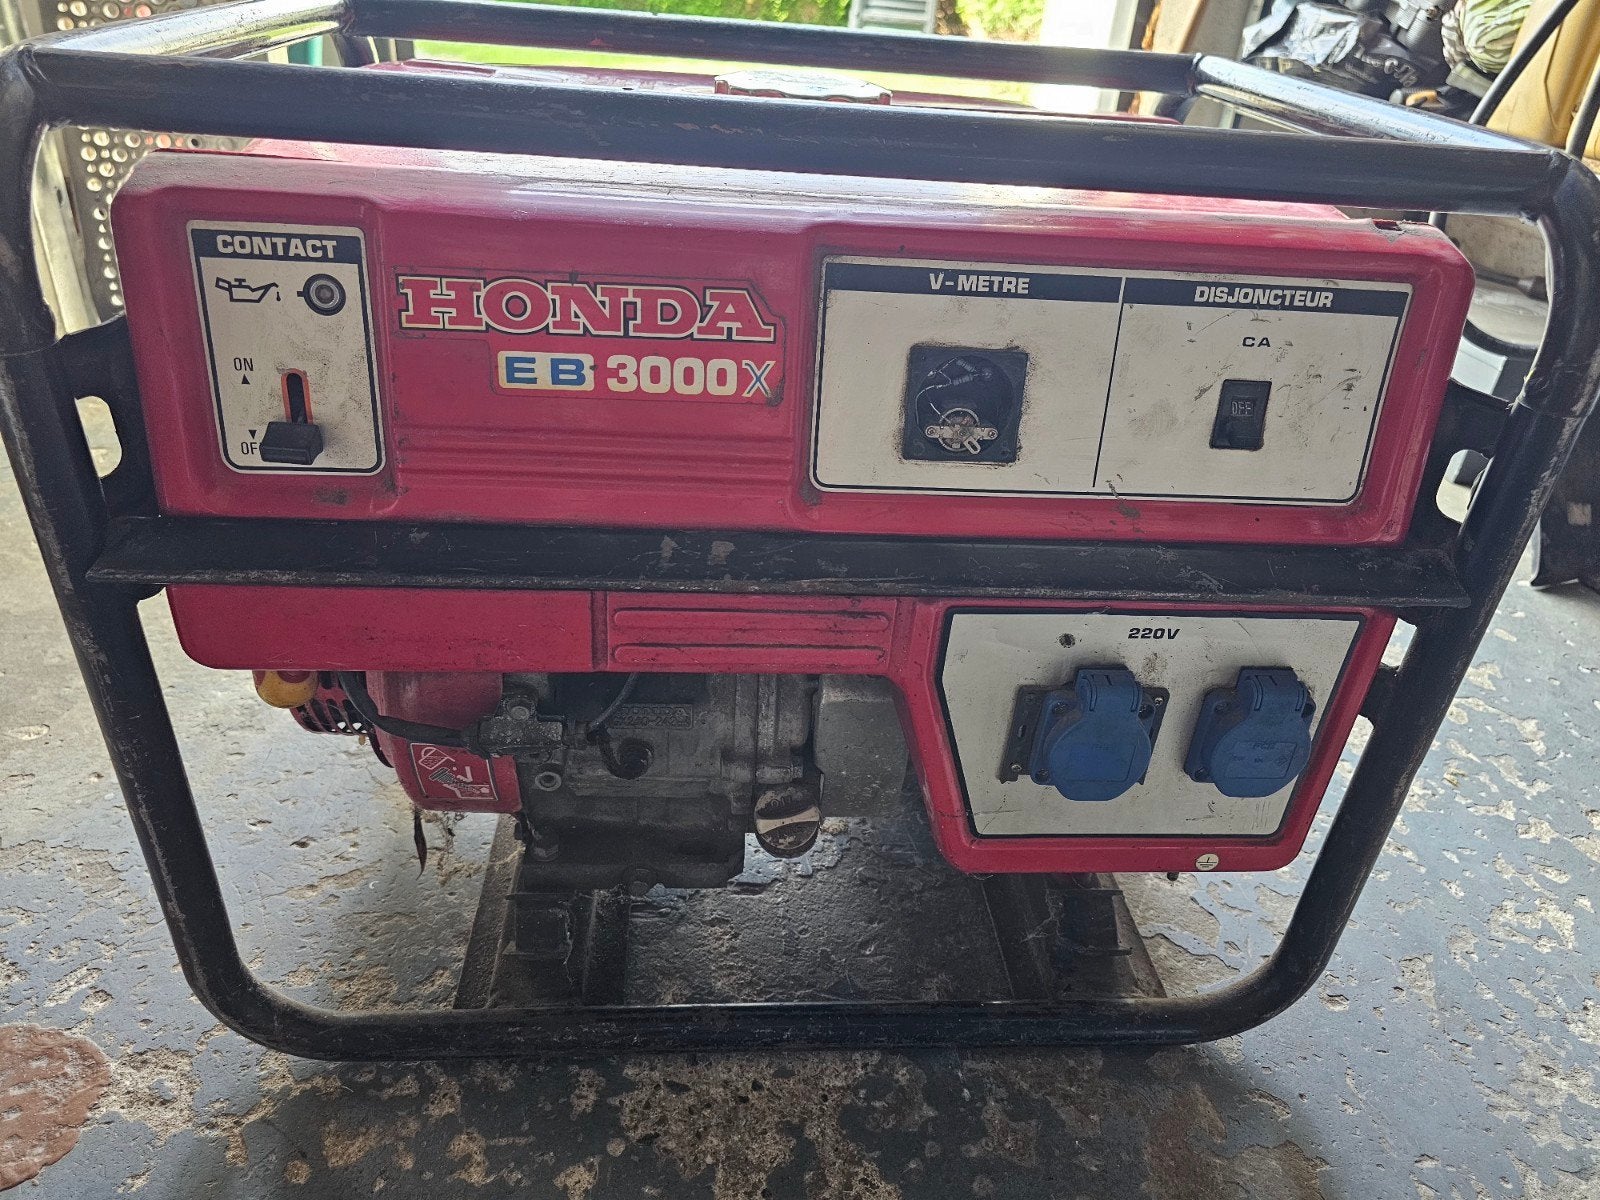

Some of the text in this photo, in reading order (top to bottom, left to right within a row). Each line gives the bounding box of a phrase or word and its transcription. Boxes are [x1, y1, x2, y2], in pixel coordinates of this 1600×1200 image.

[216, 234, 338, 259] CONTACT
[929, 272, 1031, 295] V-METRE
[1193, 285, 1334, 309] DISJONCTEUR
[396, 274, 777, 343] HONDA
[1241, 336, 1272, 348] CA
[233, 357, 254, 372] ON
[504, 355, 587, 387] EB
[1231, 400, 1252, 415] OFF
[240, 441, 258, 455] OF
[1127, 627, 1181, 640] 220V
